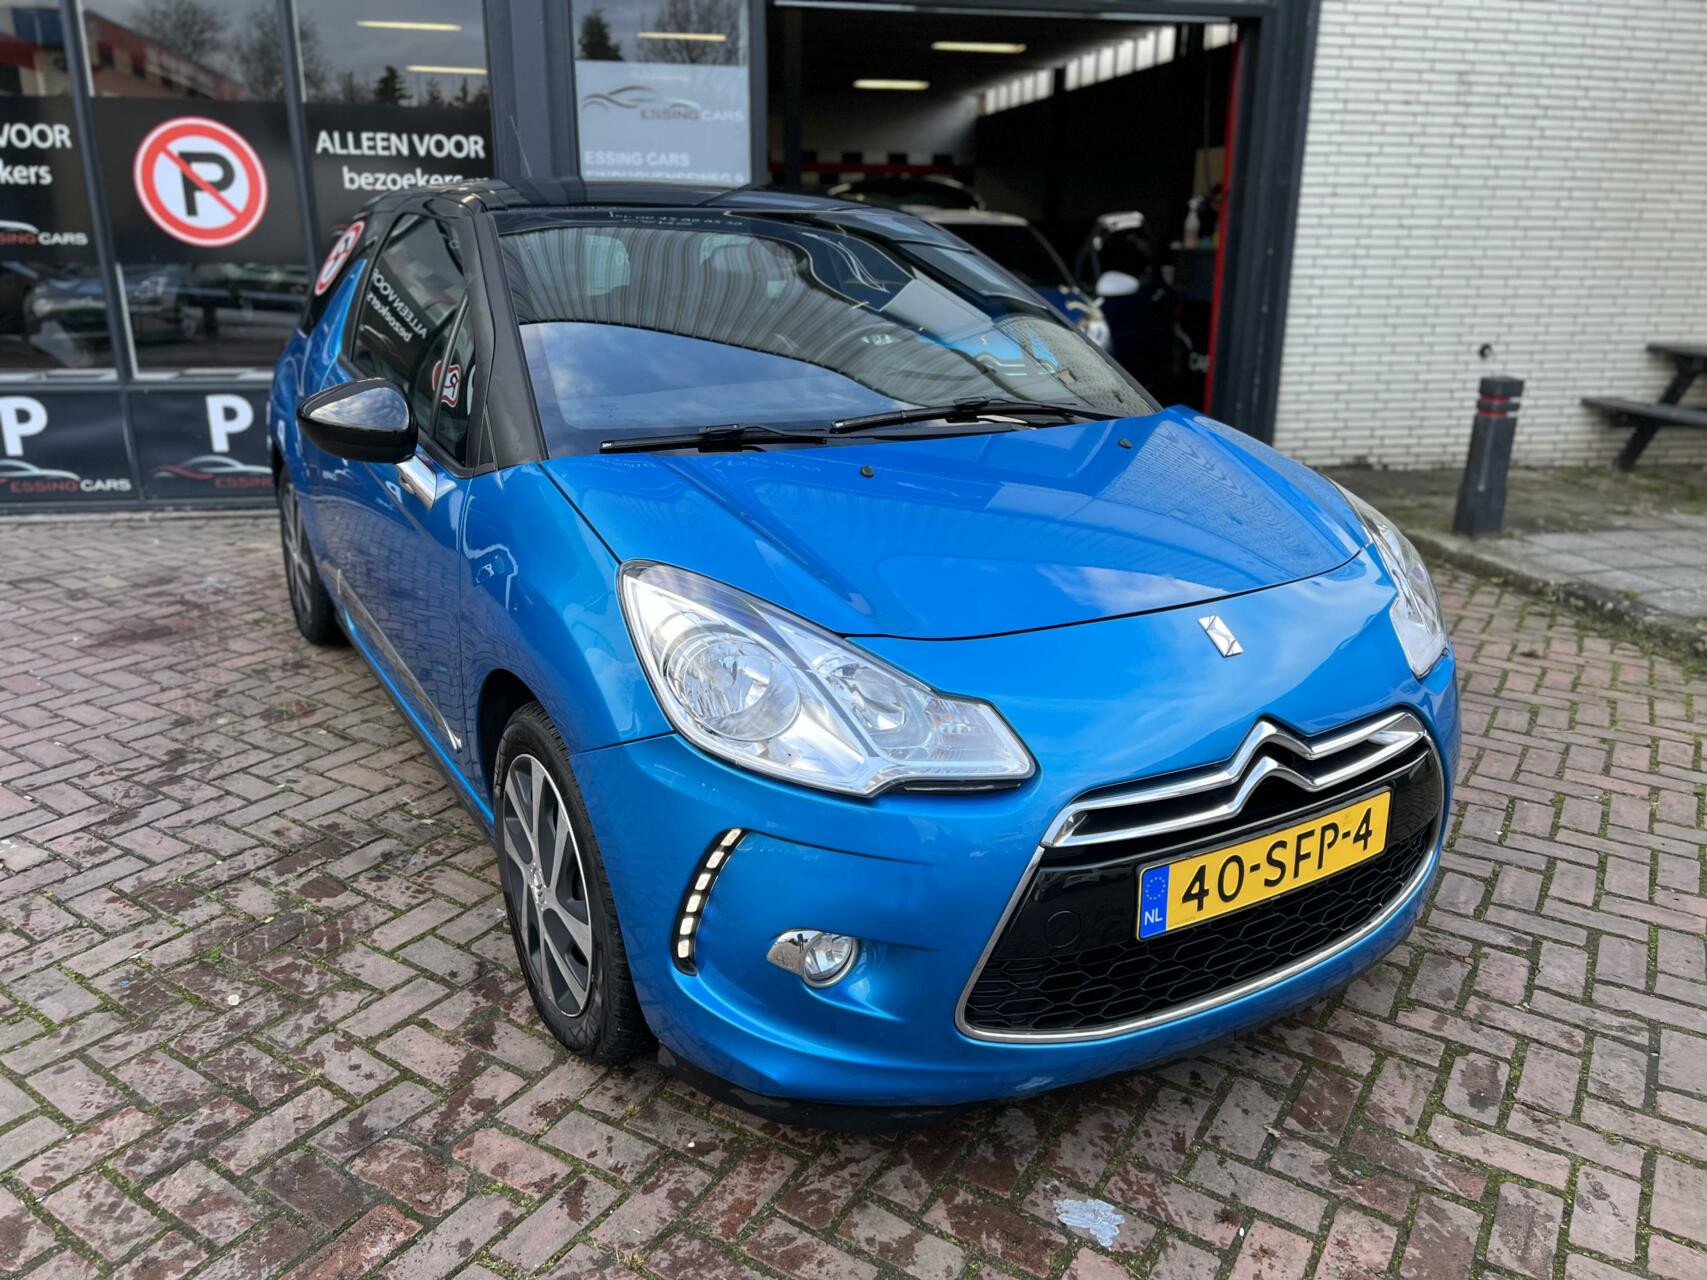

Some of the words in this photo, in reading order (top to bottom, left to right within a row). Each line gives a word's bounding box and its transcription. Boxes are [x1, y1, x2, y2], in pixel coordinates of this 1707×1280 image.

[640, 108, 699, 121] ESSING
[701, 110, 744, 123] CARS
[315, 130, 409, 156] ALLEEN
[411, 133, 486, 159] VOOR
[584, 151, 643, 166] ESSING
[646, 152, 691, 167] CARS
[38, 232, 88, 245] CARS
[0, 395, 48, 456] P
[205, 393, 254, 453] P
[80, 478, 132, 492] CARS
[1181, 807, 1373, 912] 40-SFP-4
[1144, 907, 1163, 926] NL
